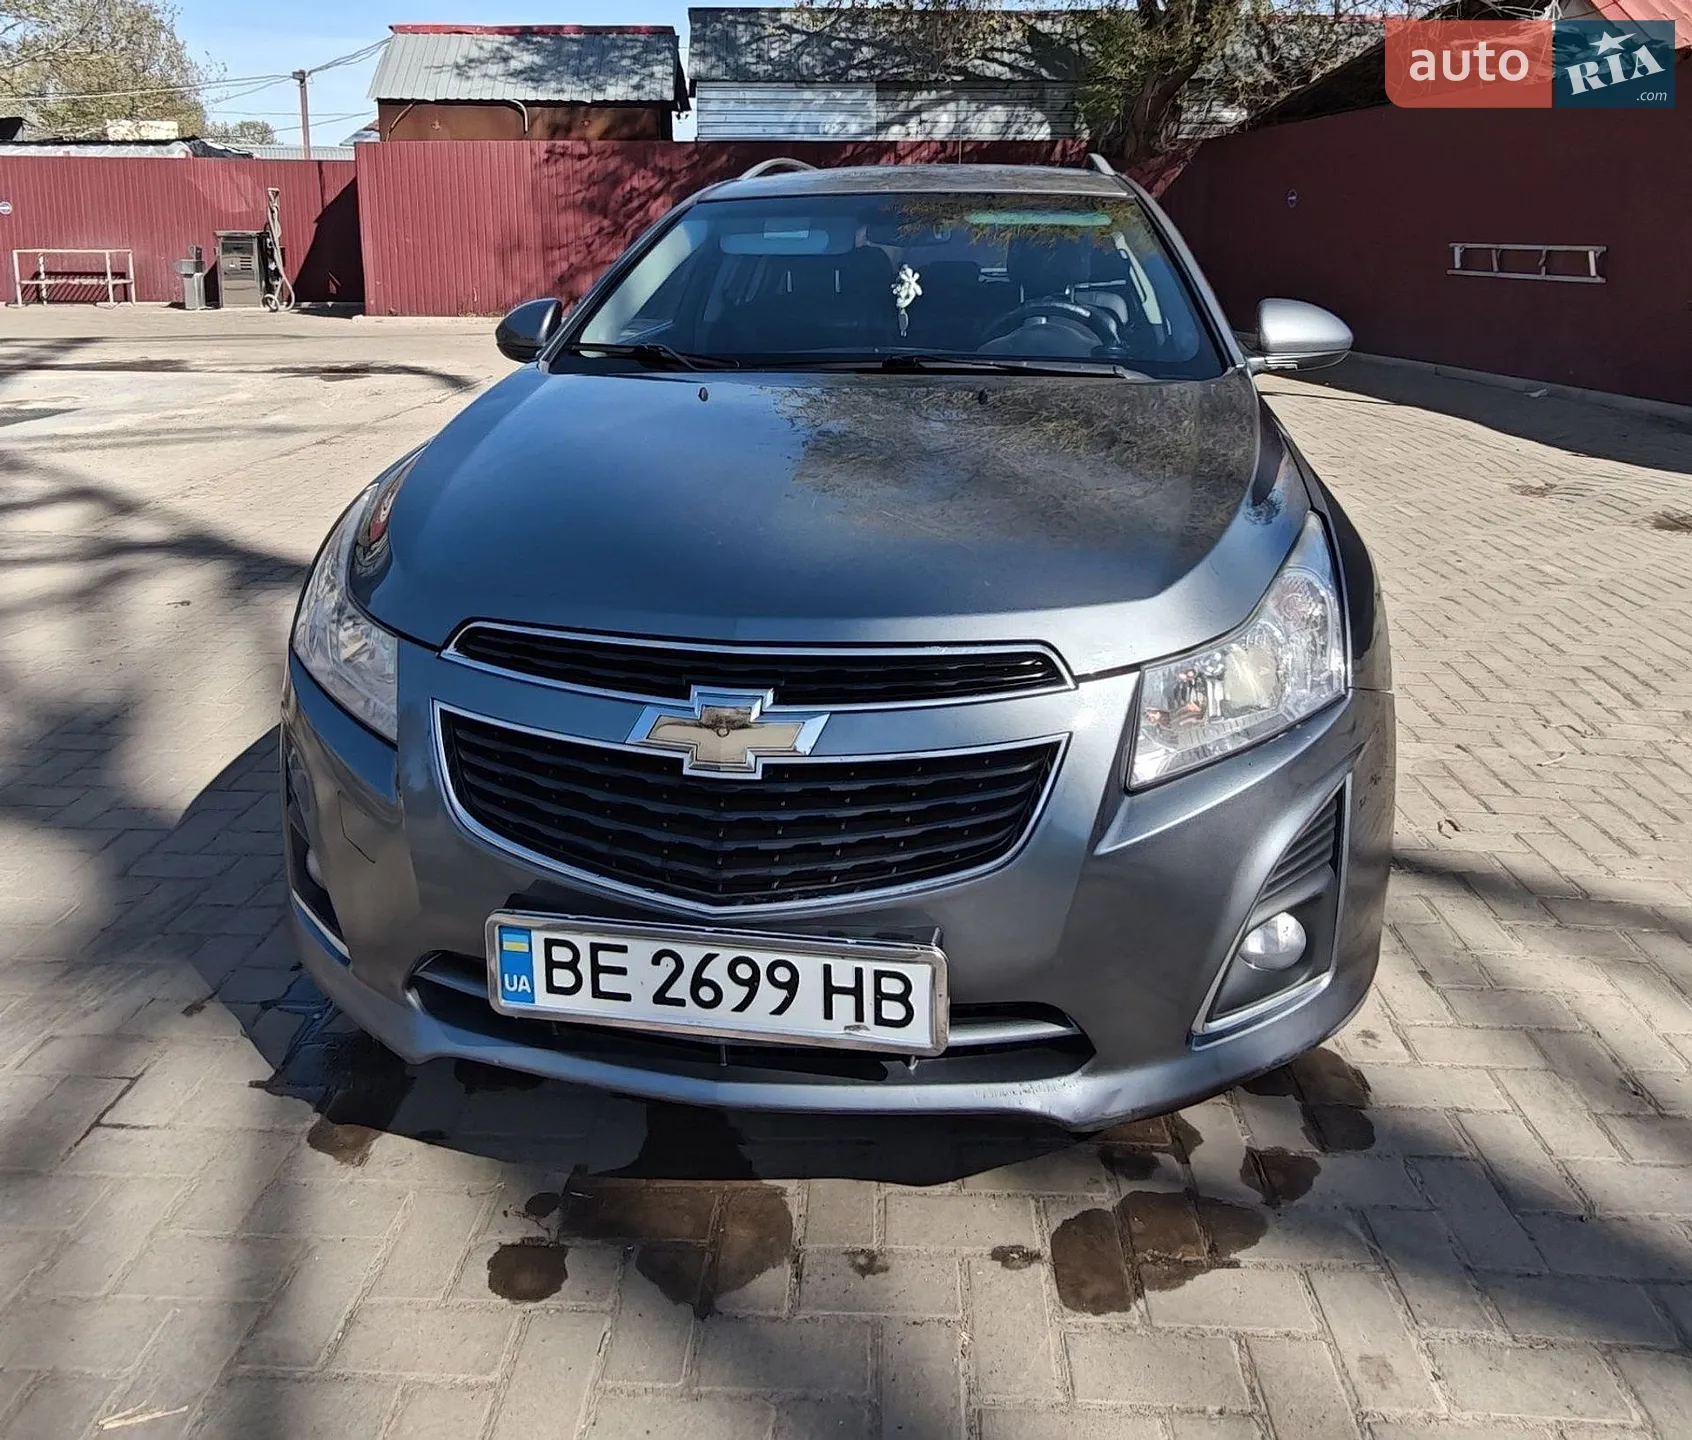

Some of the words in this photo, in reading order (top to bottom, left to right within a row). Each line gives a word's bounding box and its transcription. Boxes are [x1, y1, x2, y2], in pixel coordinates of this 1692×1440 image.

[504, 974, 532, 994] UA
[543, 937, 632, 1002] BE
[650, 949, 801, 1016] 2699
[822, 963, 915, 1028] HB
